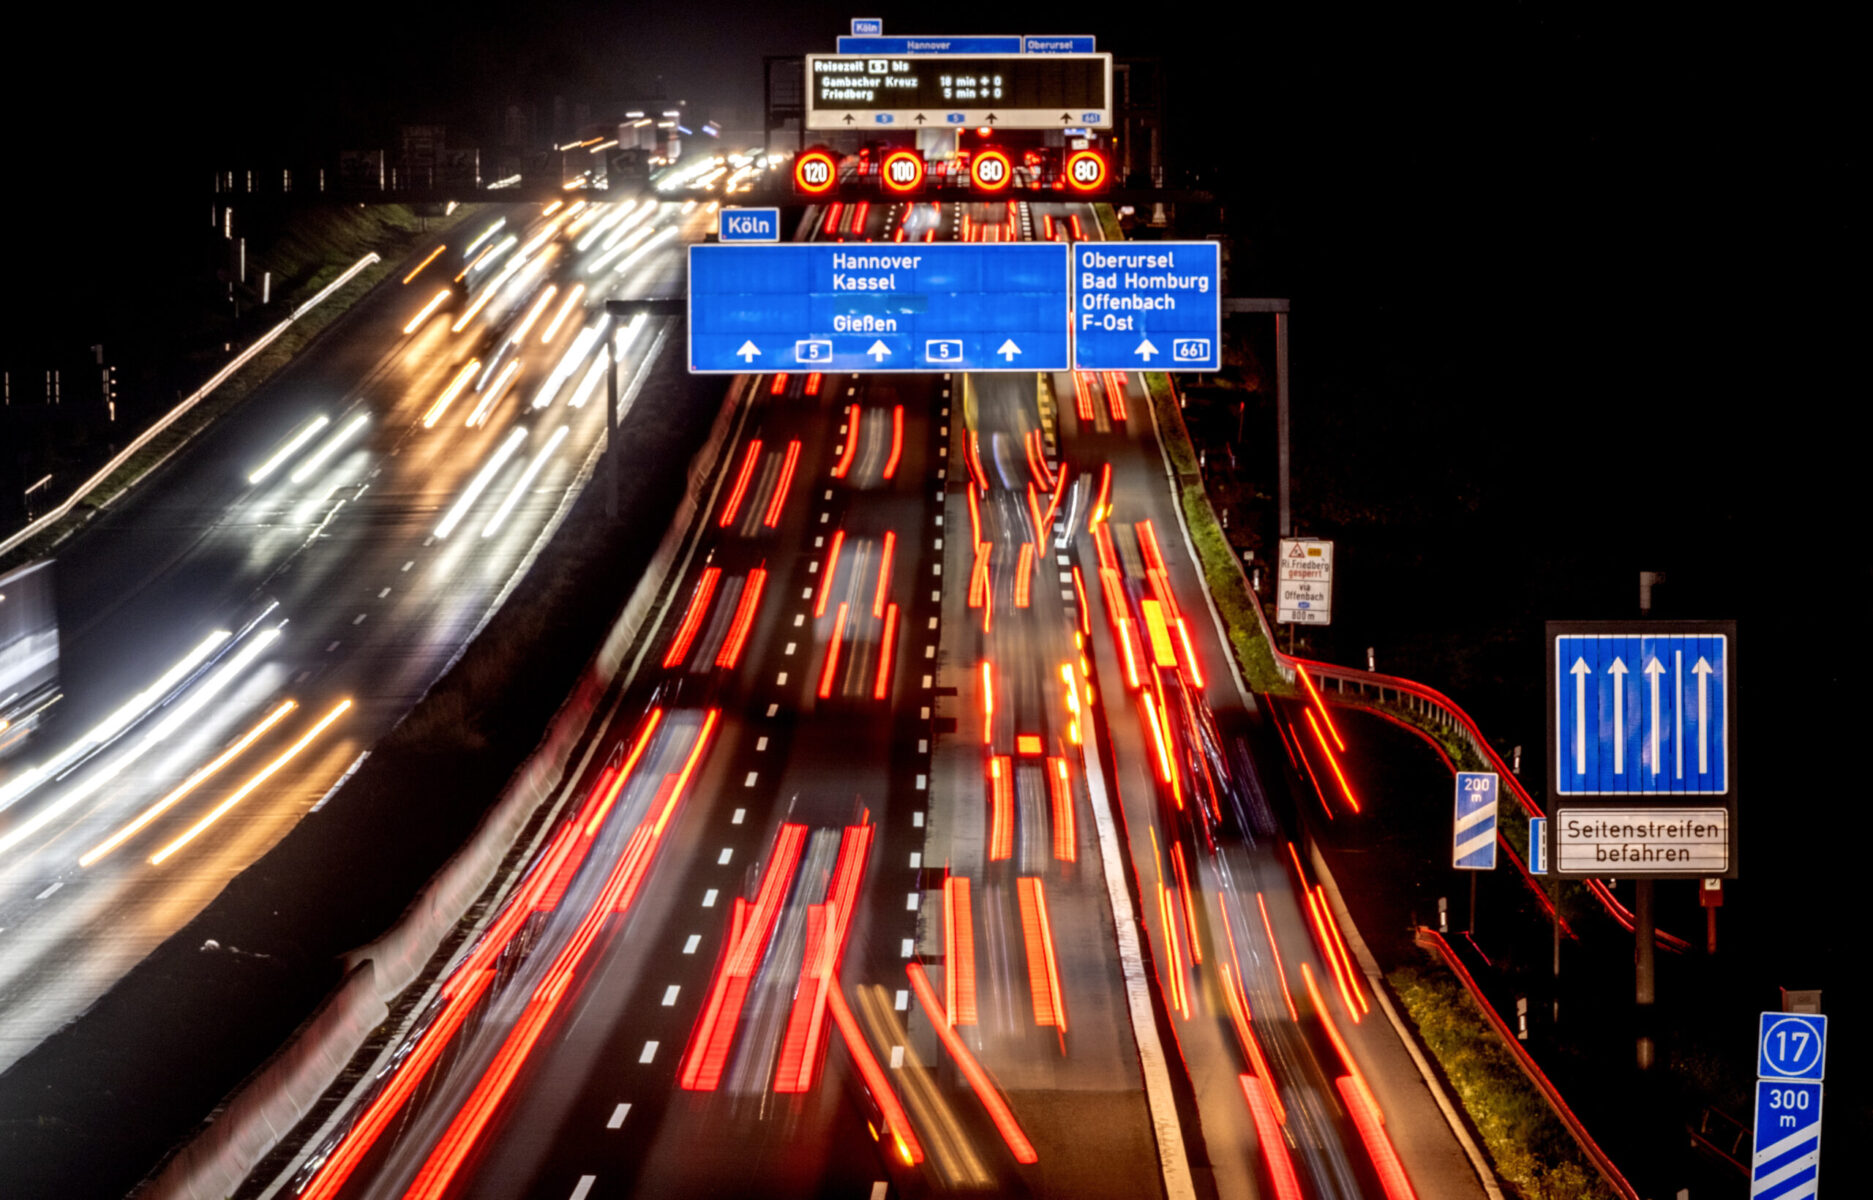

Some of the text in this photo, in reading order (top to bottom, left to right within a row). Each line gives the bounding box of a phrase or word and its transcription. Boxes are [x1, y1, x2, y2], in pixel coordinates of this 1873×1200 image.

[856, 22, 877, 32] Köln
[907, 40, 950, 50] Hannover
[1028, 40, 1073, 50] Oberursel
[814, 60, 864, 72] Reisezeit
[892, 60, 909, 72] bis
[822, 76, 881, 87] Gambacher
[885, 76, 918, 87] Kreuz
[956, 76, 976, 87] min
[993, 75, 1002, 87] 0
[822, 88, 874, 101] Friedberg
[944, 88, 952, 99] 5
[956, 88, 976, 98] min
[993, 88, 1002, 98] 0
[804, 162, 828, 182] 120
[891, 161, 915, 182] 100
[979, 160, 1003, 181] 80
[1074, 160, 1098, 181] 80
[728, 217, 770, 233] Köln
[833, 253, 921, 269] Hannover
[1082, 252, 1174, 268] Oberursel
[833, 273, 896, 290] Kassel
[1082, 272, 1209, 293] Bad Homburg
[1082, 293, 1175, 310] Offenbach
[833, 315, 897, 332] Gießen
[1082, 314, 1134, 331] F-Ost
[809, 344, 819, 358] 5
[940, 344, 949, 358] 5
[1180, 343, 1204, 357] 661
[1288, 569, 1322, 579] gesperrt
[1285, 591, 1324, 601] Offenbach
[1464, 778, 1490, 791] 200
[1471, 793, 1482, 803] m
[1567, 820, 1719, 839] Seitenstreifen
[1596, 844, 1690, 862] befahren
[1776, 1031, 1810, 1062] 17
[1769, 1089, 1810, 1110] 300
[1780, 1115, 1796, 1127] m
